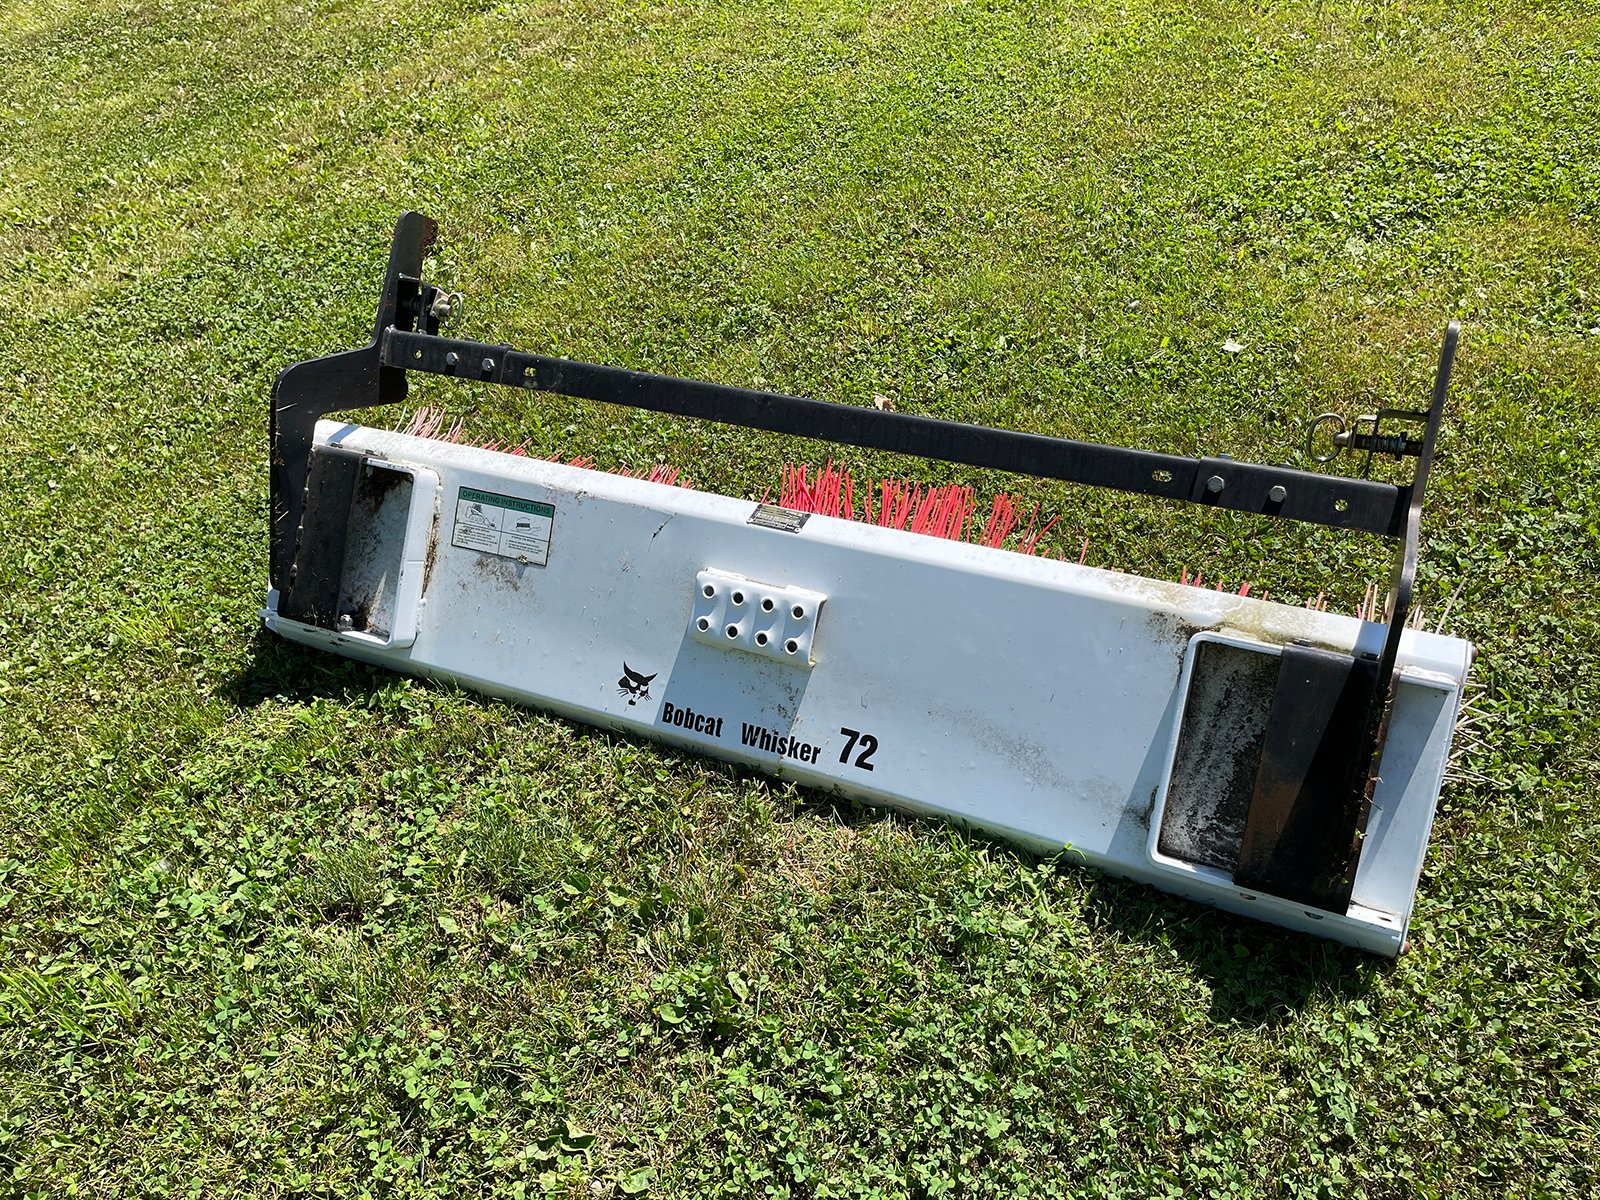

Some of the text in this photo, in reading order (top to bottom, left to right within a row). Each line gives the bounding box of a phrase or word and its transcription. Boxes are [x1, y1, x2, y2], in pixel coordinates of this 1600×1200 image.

[462, 490, 551, 515] OPERATING INSTRUCTIONS
[661, 702, 879, 772] Bobcat Whisker 72
